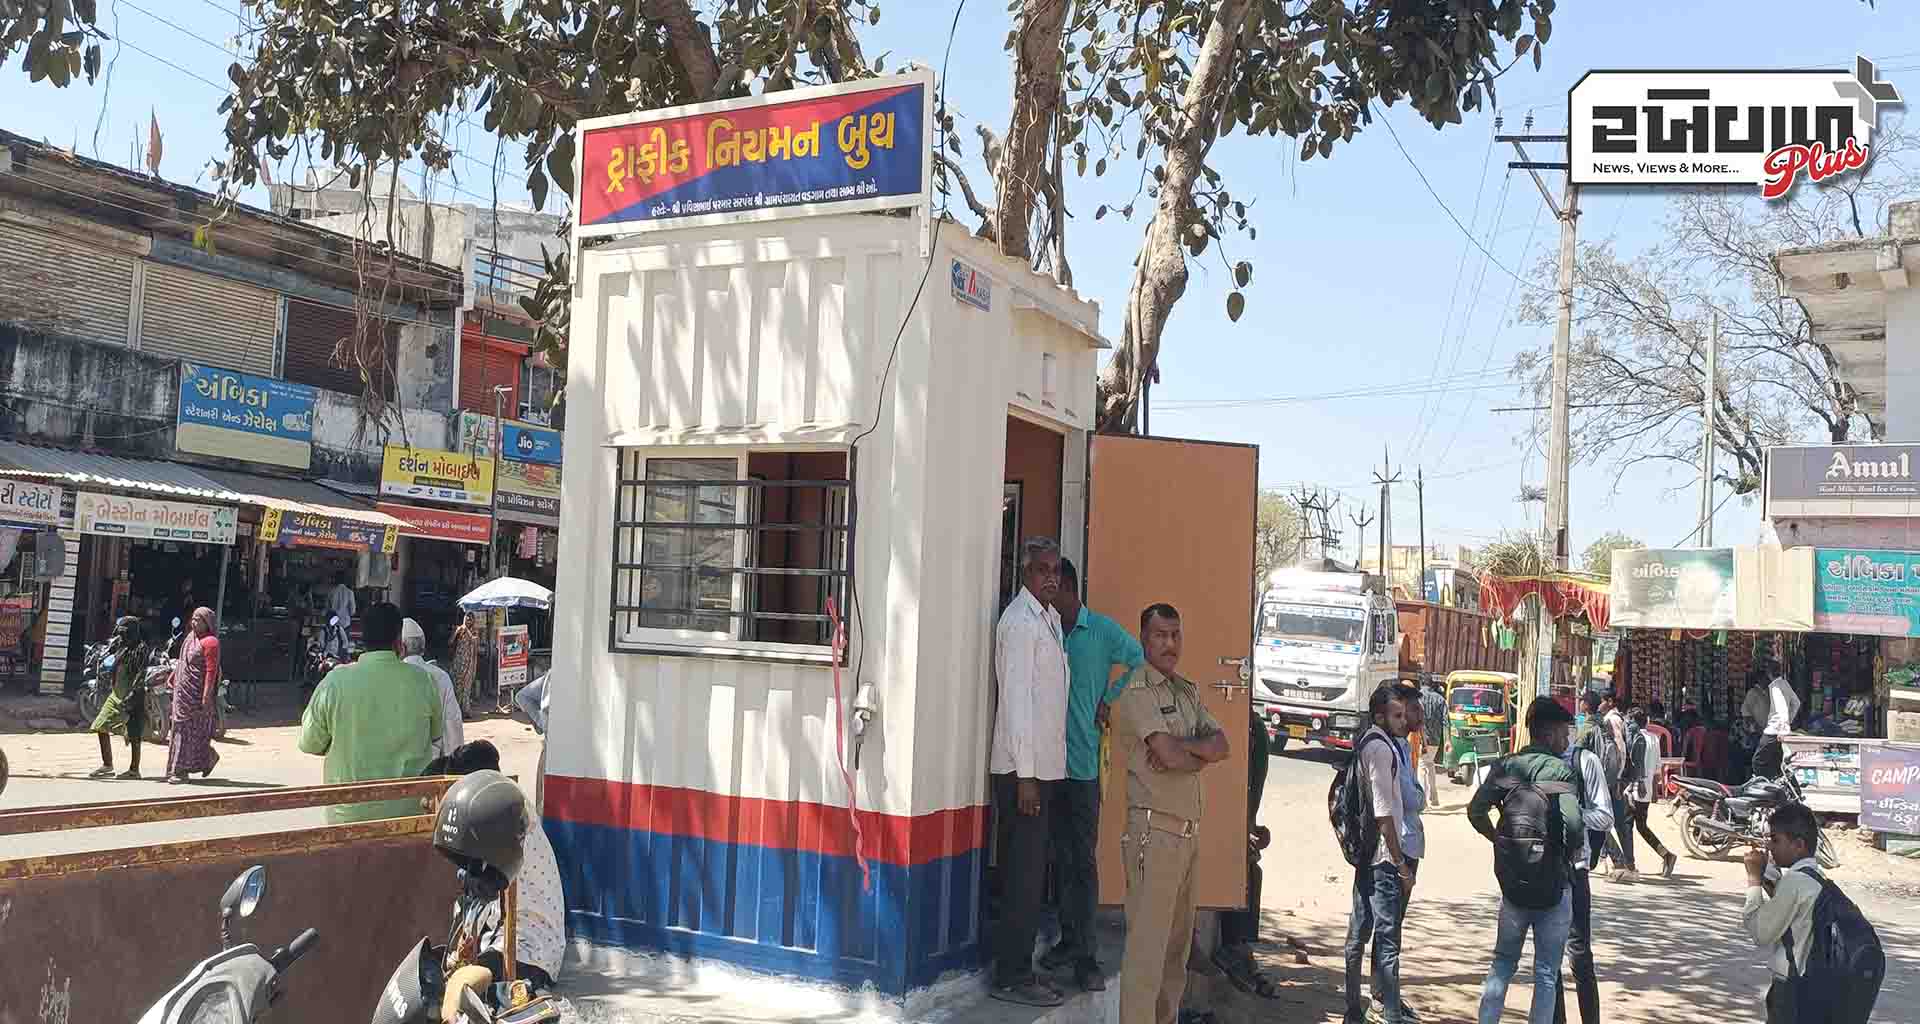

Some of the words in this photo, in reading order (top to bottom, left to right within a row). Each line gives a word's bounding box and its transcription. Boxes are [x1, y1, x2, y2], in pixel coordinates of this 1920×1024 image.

[607, 127, 691, 193] ટ્રાફીક
[706, 118, 821, 169] નિયમન
[838, 111, 896, 170] બુથ
[754, 193, 763, 206] શ્રી
[801, 189, 824, 202] વડગામ
[825, 186, 839, 200] તથા
[195, 373, 268, 409] અંબિકા
[518, 436, 533, 449] Jio
[399, 453, 429, 473] દર્શન
[1826, 451, 1911, 480] Amul
[1826, 553, 1905, 582] અંબિકા
